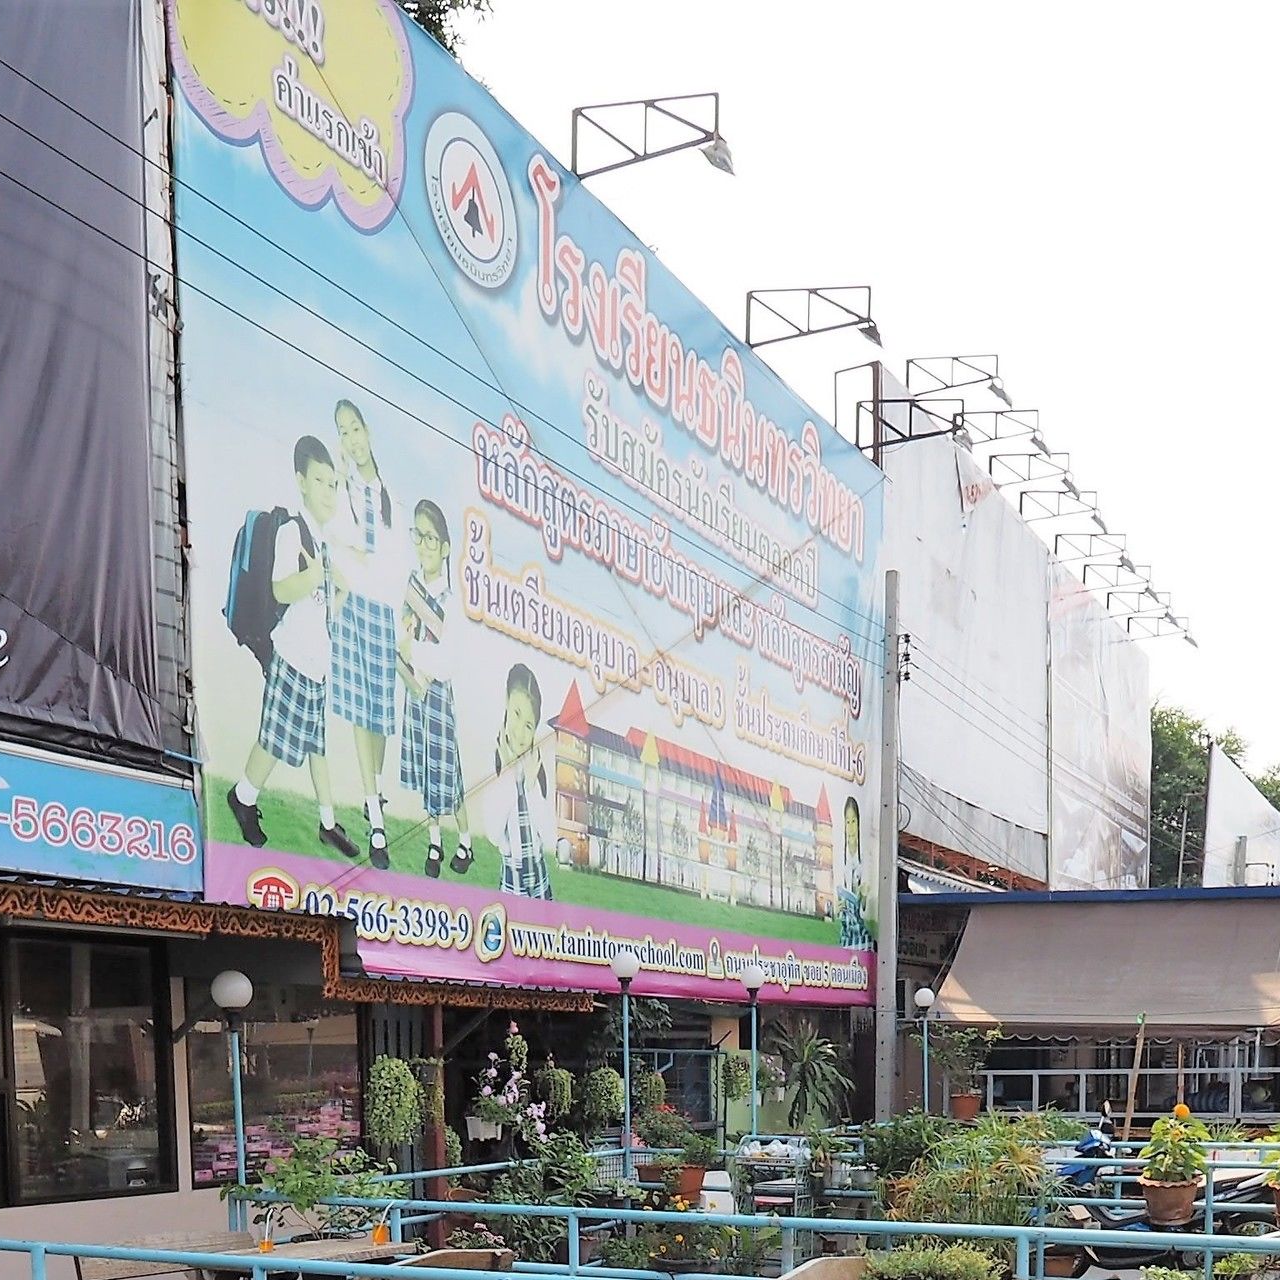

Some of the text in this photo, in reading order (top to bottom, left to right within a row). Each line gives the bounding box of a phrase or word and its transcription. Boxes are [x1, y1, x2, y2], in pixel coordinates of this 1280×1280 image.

[276, 62, 384, 182] ค่าแรกเข้า
[529, 158, 865, 560] โรงเรียนธนินทรวิทยา
[305, 890, 470, 944] 02-566-3398-9
